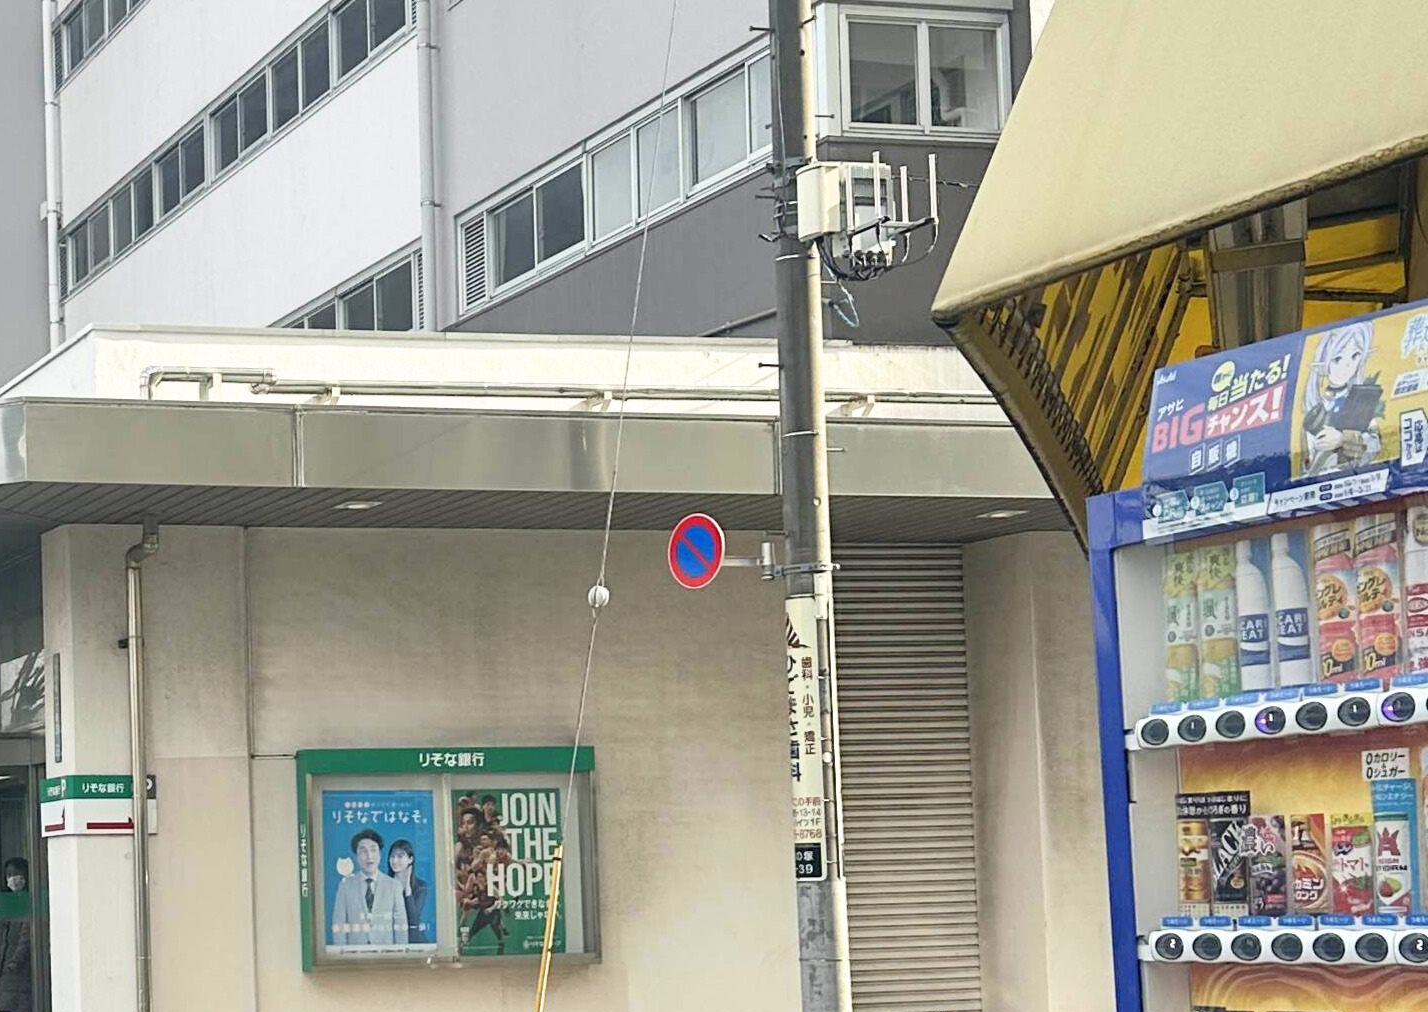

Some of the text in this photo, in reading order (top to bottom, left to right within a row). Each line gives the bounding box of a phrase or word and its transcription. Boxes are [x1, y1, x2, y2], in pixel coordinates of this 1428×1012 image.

[1158, 398, 1184, 421] アサヒ
[1207, 385, 1283, 436] チャンス!
[1152, 403, 1205, 454] BIG
[419, 752, 485, 768] りそな銀行
[82, 782, 125, 794] りそな銀行
[332, 809, 429, 824] りそなではなそ。
[499, 792, 557, 827] JOIN
[507, 827, 558, 862] THE
